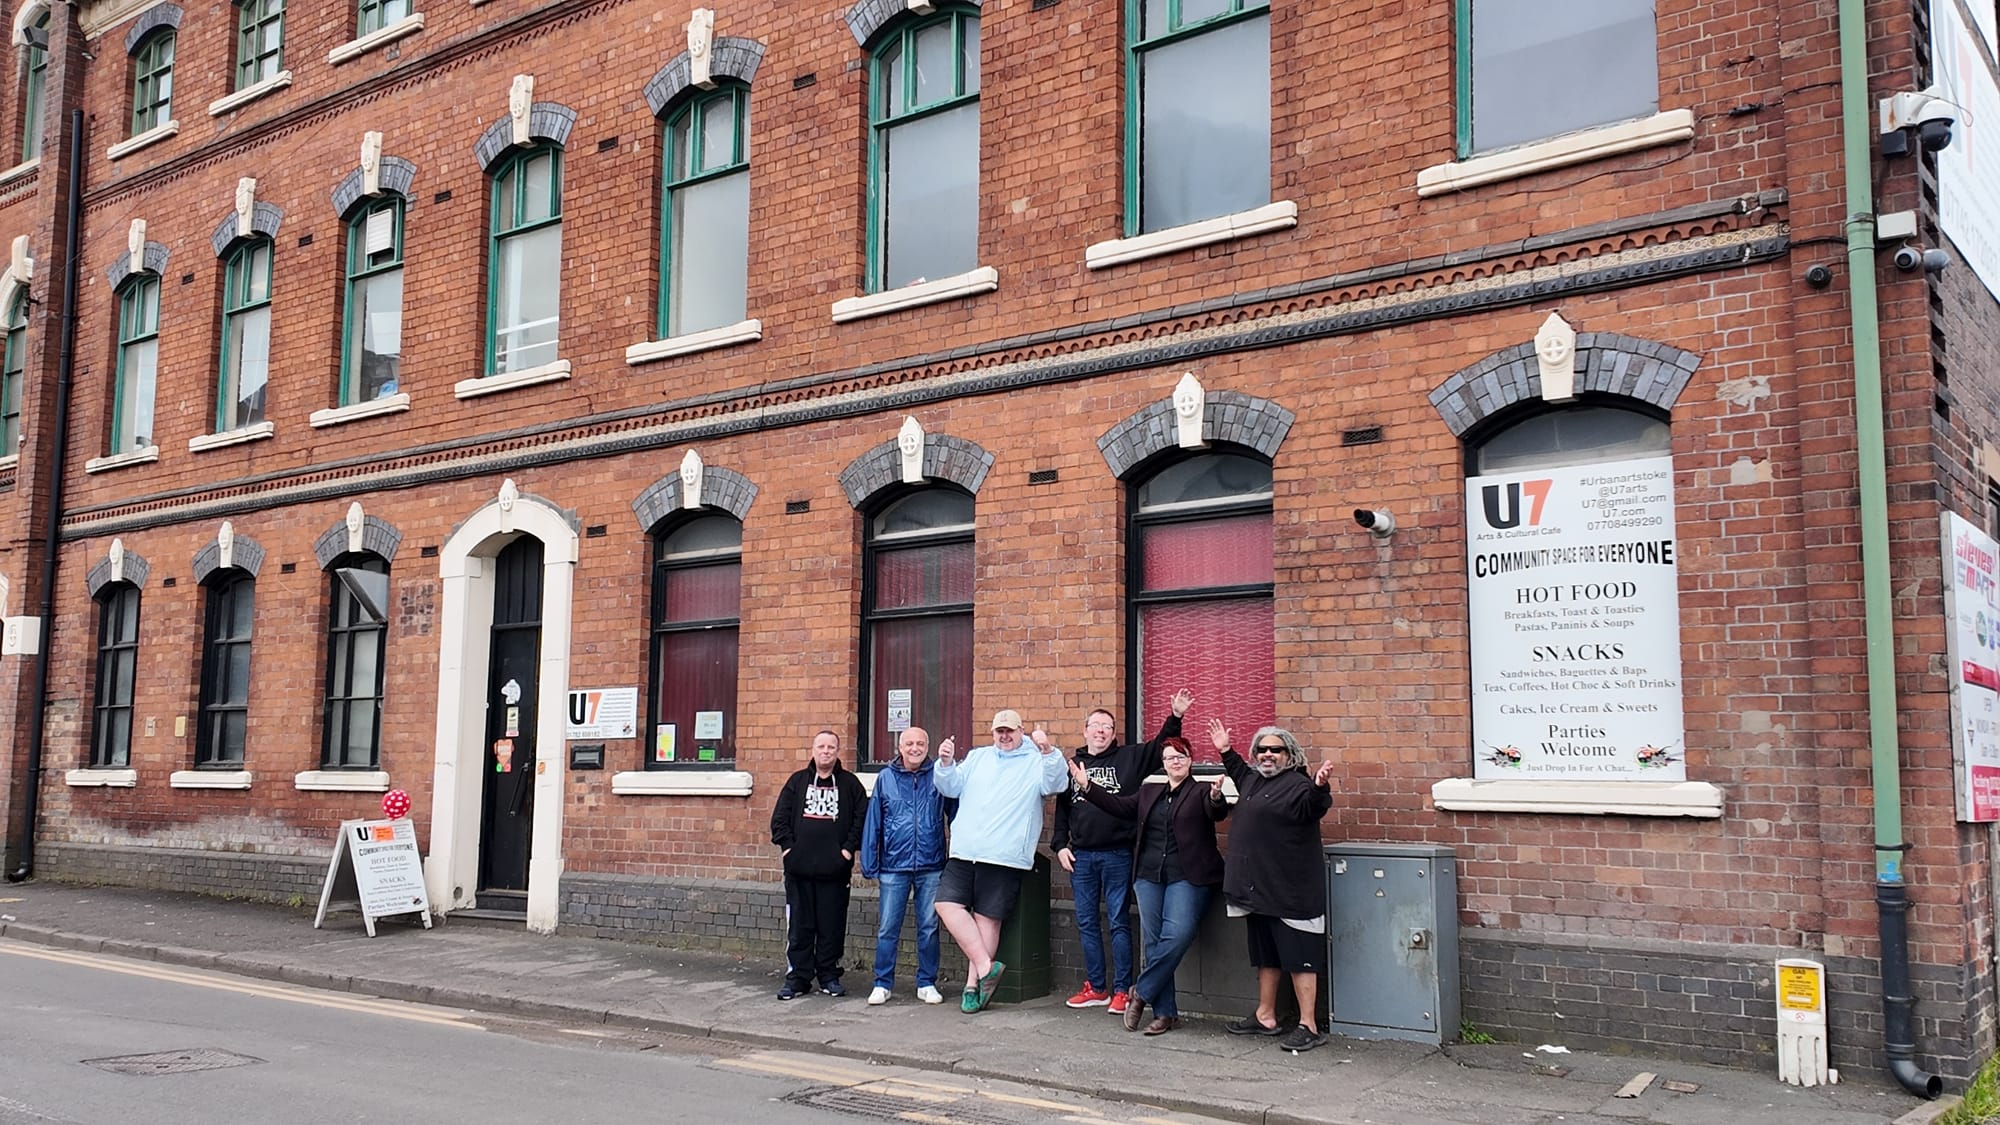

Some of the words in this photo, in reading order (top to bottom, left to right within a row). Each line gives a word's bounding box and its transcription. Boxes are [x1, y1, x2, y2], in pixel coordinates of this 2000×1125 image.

[1580, 471, 1667, 486] #Urbanartstoke
[1598, 484, 1648, 498] @U7arts
[1481, 478, 1553, 530] U7
[1582, 494, 1666, 509] U7@gmail.com
[1603, 507, 1646, 519] U7.com
[1587, 516, 1663, 531] 07708499290
[1476, 531, 1494, 541] Arts
[1496, 531, 1503, 539] &
[1505, 528, 1540, 539] Cultural
[1475, 549, 1550, 578] COMMUNITY
[1552, 547, 1578, 565] SPACE
[1579, 545, 1595, 564] FOR
[1598, 540, 1674, 565] EVERYONE
[1517, 585, 1564, 604] HOT
[1572, 581, 1637, 601] FOOD
[1504, 608, 1559, 620] Breakfasts,
[1562, 606, 1588, 617] Toast
[1591, 606, 1600, 616] &
[1604, 604, 1646, 615] Toasties
[1551, 620, 1588, 631] Paninis
[1591, 620, 1600, 629] &
[1603, 618, 1635, 630] Soups
[1532, 642, 1625, 663] SNACKS
[1559, 666, 1607, 678] Baguettes
[1609, 666, 1619, 676] &
[1622, 666, 1648, 677] Baps
[1551, 680, 1570, 691] Hot
[1573, 680, 1599, 690] Choc
[1602, 680, 1611, 690] &
[1615, 678, 1636, 689] Soft
[1639, 677, 1677, 689] Drinks
[569, 692, 602, 725] U7
[1500, 703, 1537, 715] Cakes,
[1540, 703, 1557, 714] Ice
[1559, 703, 1599, 714] Cream
[1603, 703, 1613, 713] &
[1618, 702, 1659, 713] Sweets
[1548, 723, 1606, 739] Parties
[1541, 741, 1617, 757] Welcome
[1527, 764, 1543, 772] Just
[1545, 764, 1566, 774] Drop
[1568, 764, 1577, 772] In
[1579, 764, 1594, 772] For
[806, 786, 839, 803] RUN
[804, 800, 840, 817] 303
